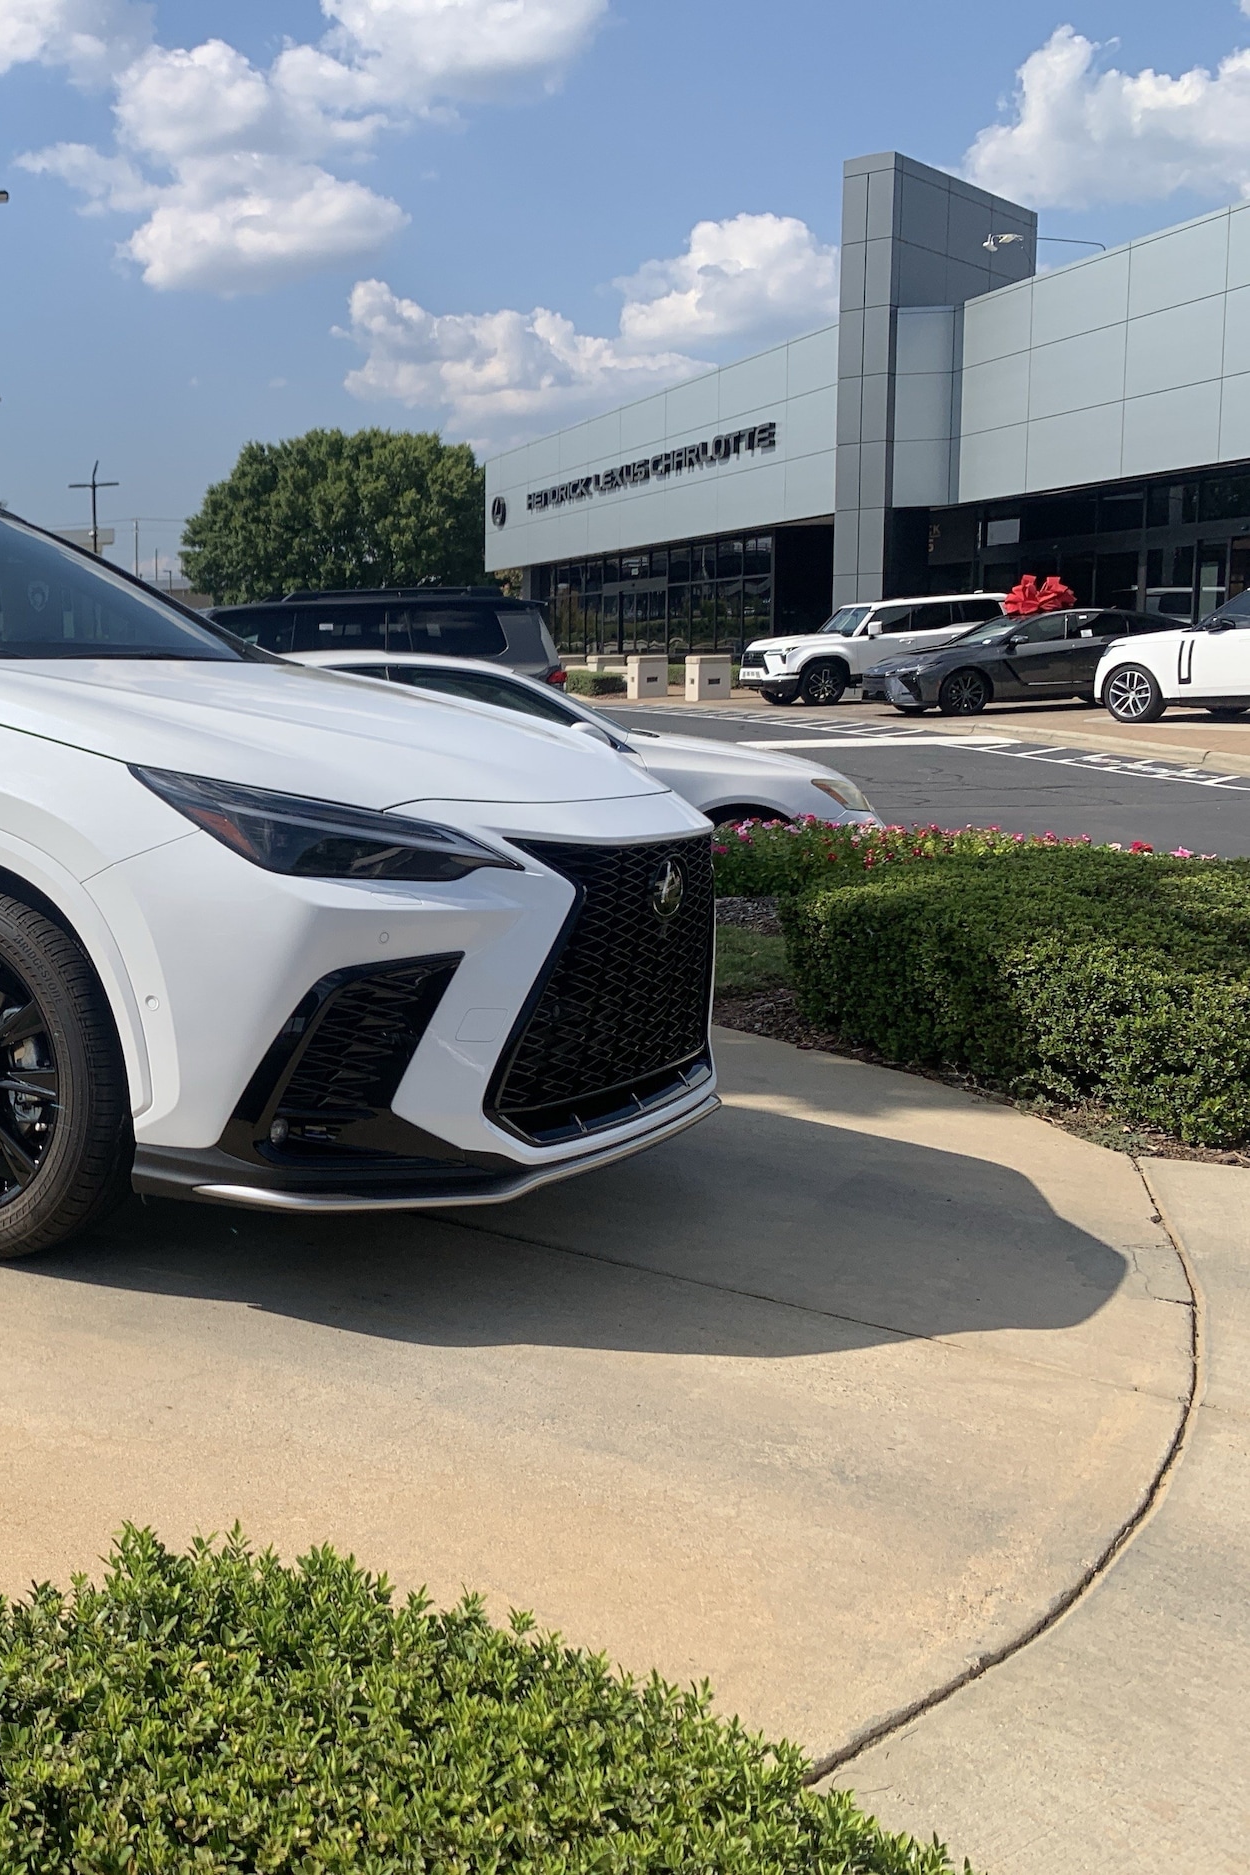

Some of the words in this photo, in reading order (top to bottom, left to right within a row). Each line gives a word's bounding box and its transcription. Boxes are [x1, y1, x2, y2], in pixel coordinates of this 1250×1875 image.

[527, 476, 593, 510] HENDRICK
[593, 459, 650, 491] LEXUS
[650, 422, 776, 475] CHARLOTTE
[13, 934, 63, 1004] BRIDGESTONE
